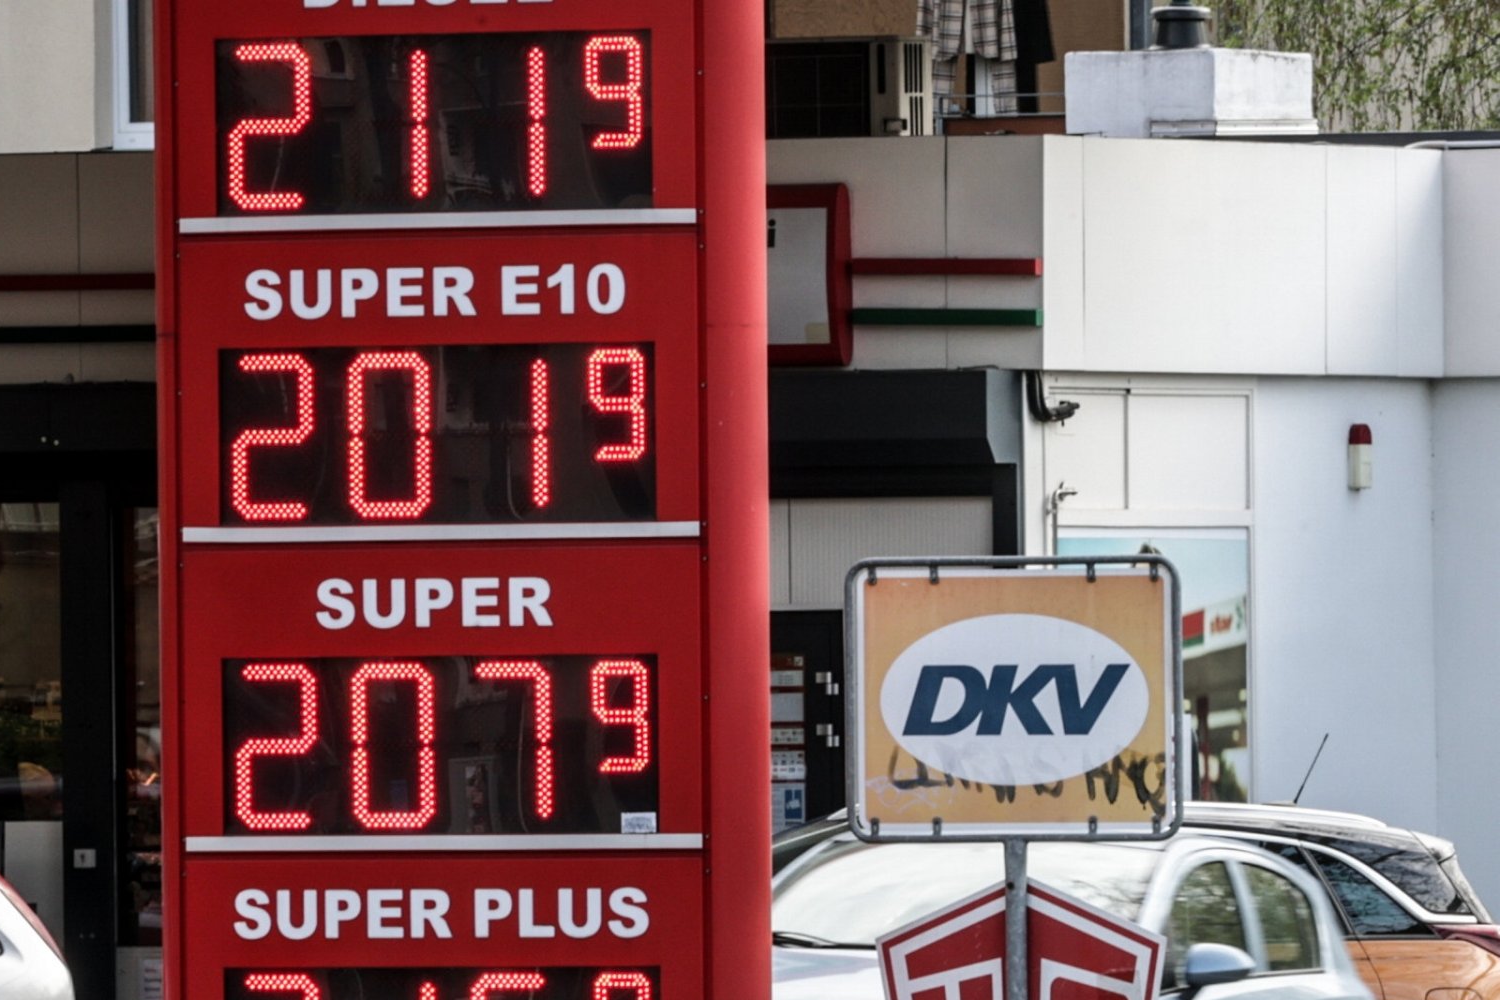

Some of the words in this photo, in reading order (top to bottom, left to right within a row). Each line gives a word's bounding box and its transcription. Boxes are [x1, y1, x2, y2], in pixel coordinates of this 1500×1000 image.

[245, 267, 476, 320] SUPER
[501, 263, 626, 315] E10
[316, 577, 553, 629] SUPER
[902, 664, 1130, 736] DKV
[234, 889, 452, 940] SUPER
[474, 887, 650, 938] PLUS
